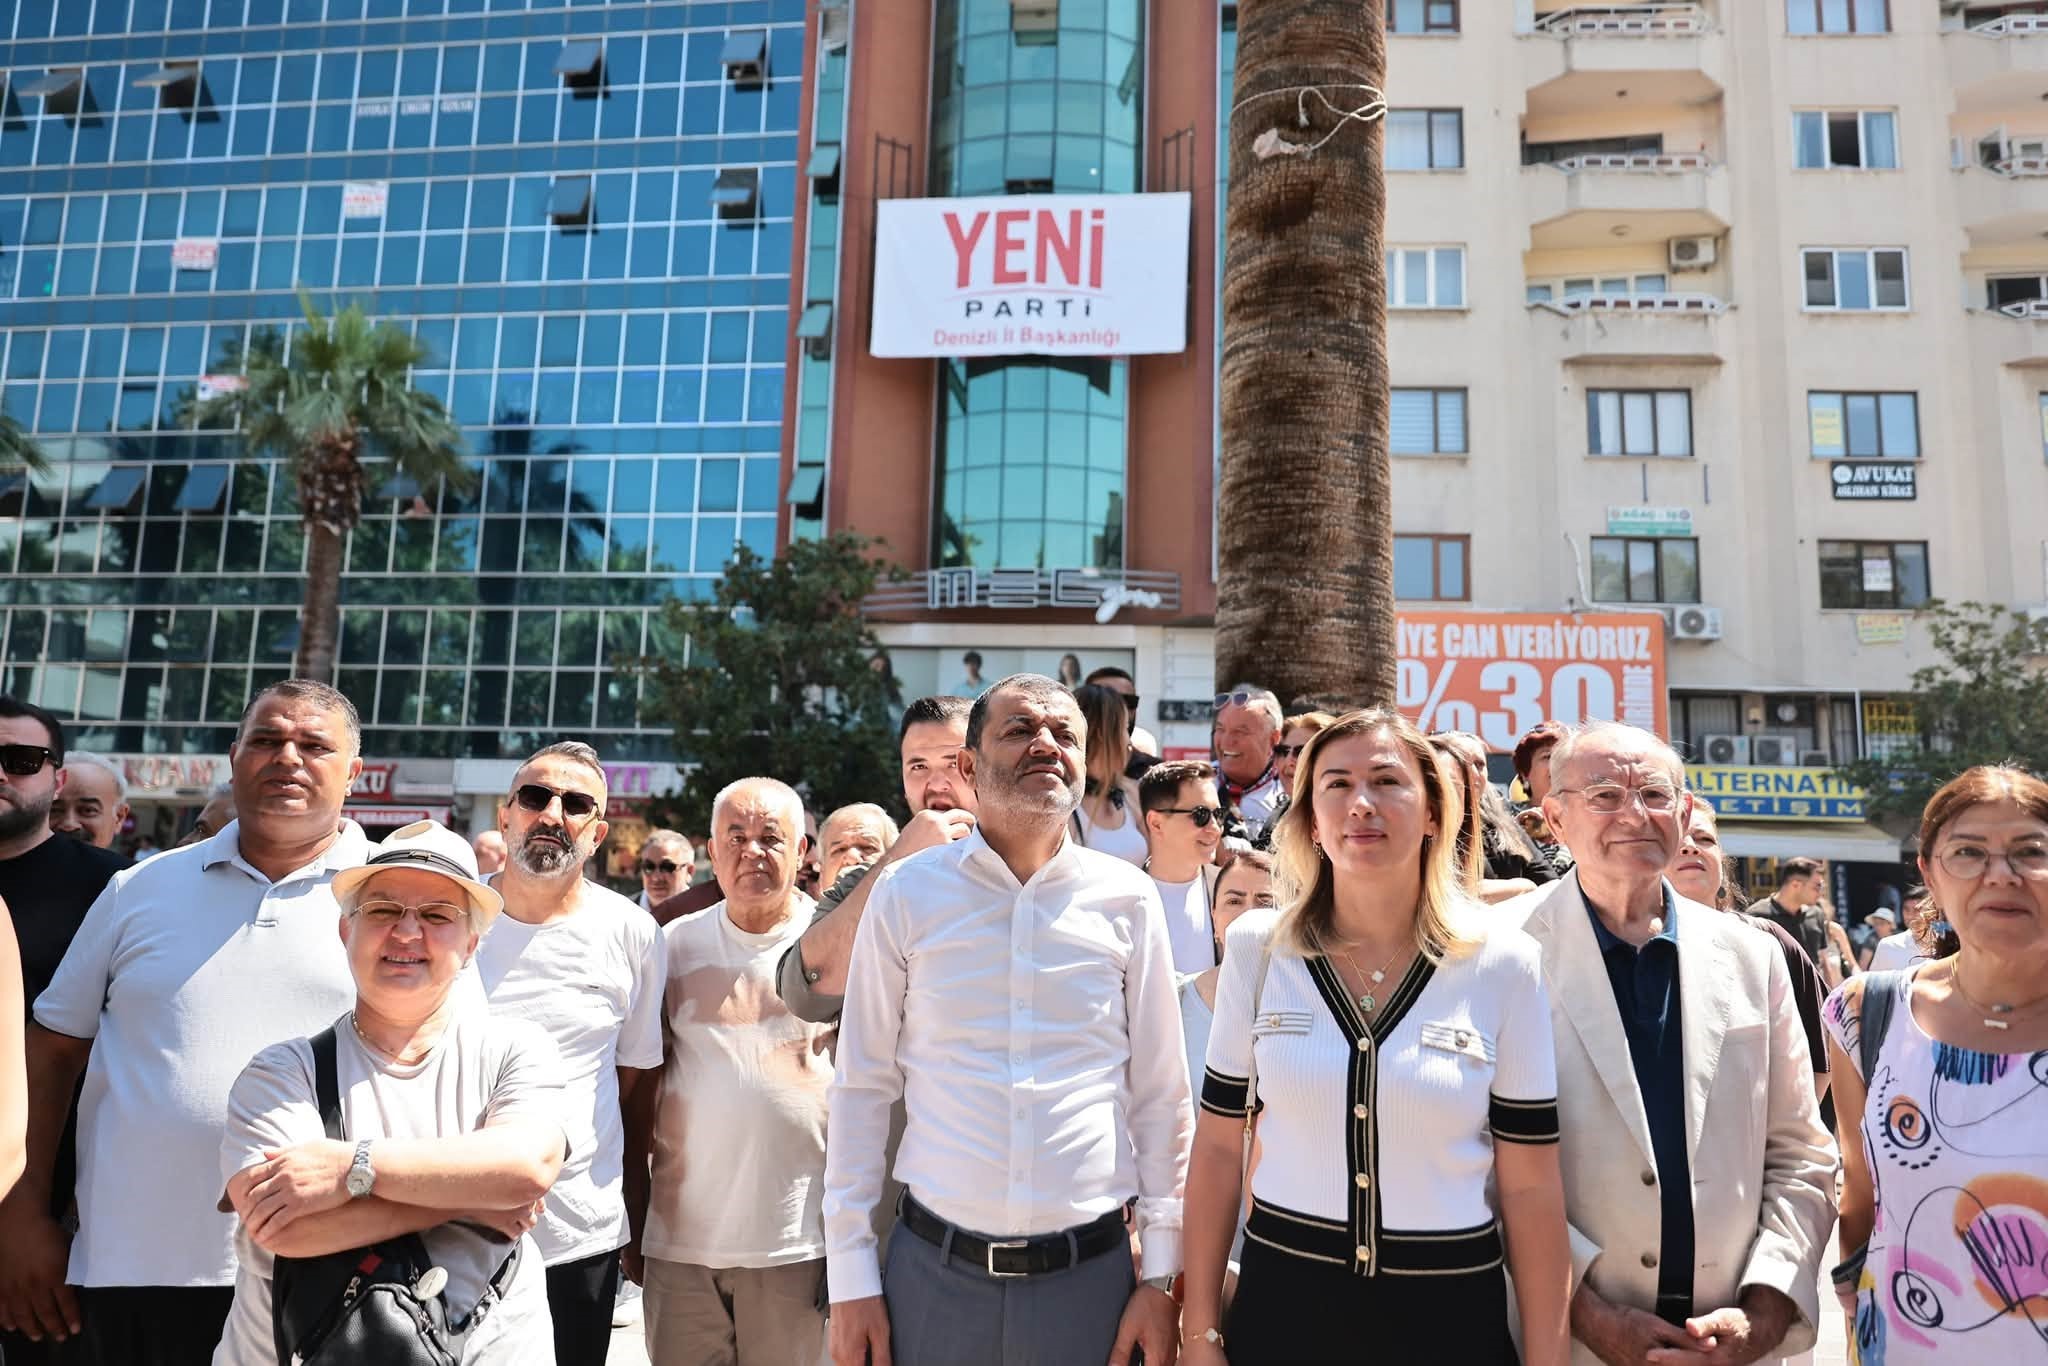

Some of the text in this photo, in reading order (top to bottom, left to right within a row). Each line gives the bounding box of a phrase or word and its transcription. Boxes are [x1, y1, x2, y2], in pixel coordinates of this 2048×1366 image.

[933, 329, 998, 346] Denizli
[1020, 326, 1121, 347] Başkanlığı
[1443, 624, 1497, 658] CAN
[1502, 621, 1650, 660] VERİYORUZ
[1397, 659, 1615, 752] %30
